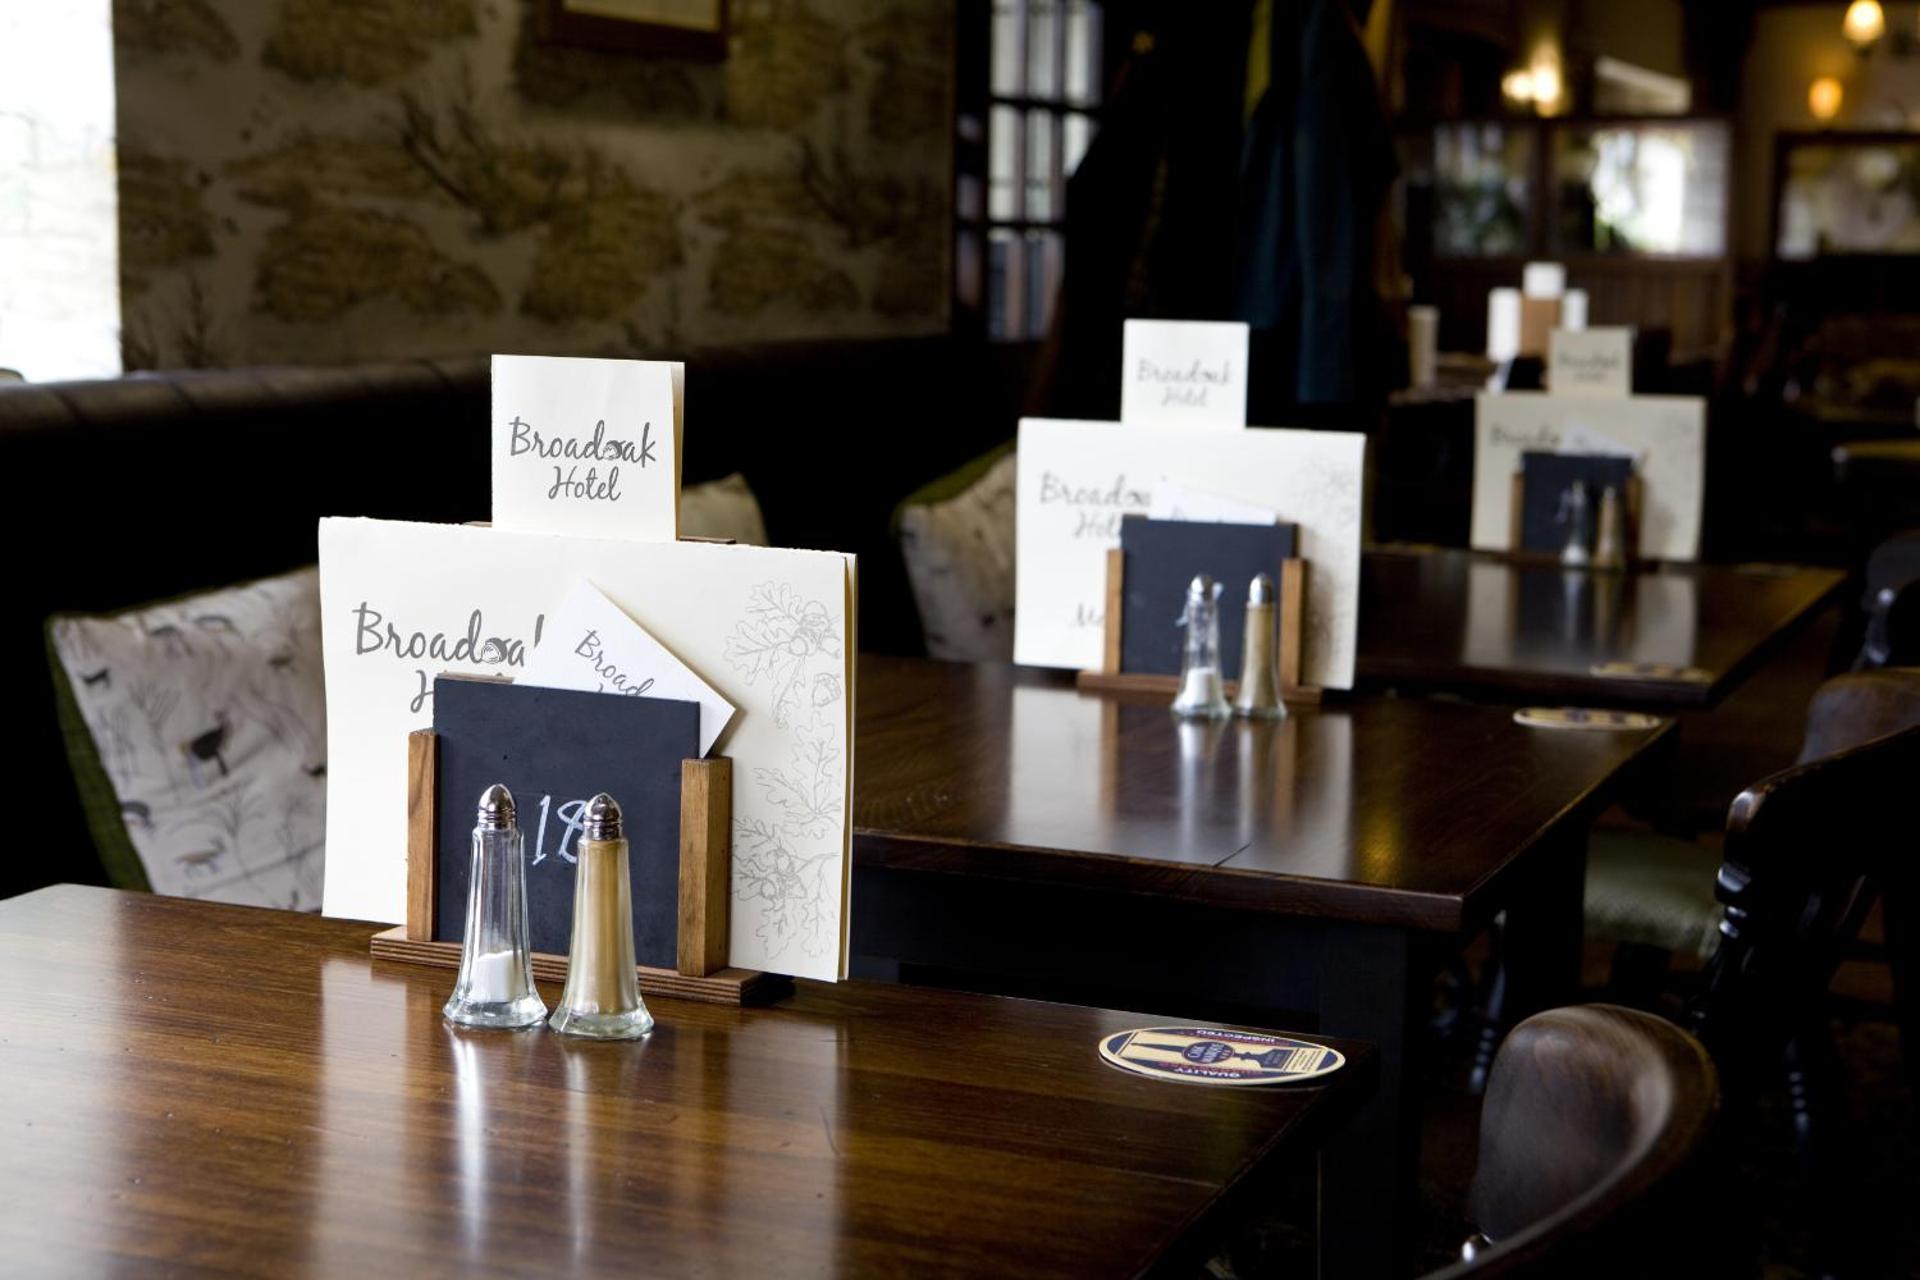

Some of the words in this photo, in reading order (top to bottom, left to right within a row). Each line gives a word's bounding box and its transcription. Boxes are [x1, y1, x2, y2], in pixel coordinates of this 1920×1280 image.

[508, 416, 656, 468] Broadoak
[548, 465, 622, 501] Hotel
[1174, 1067, 1241, 1078] QUALITY
